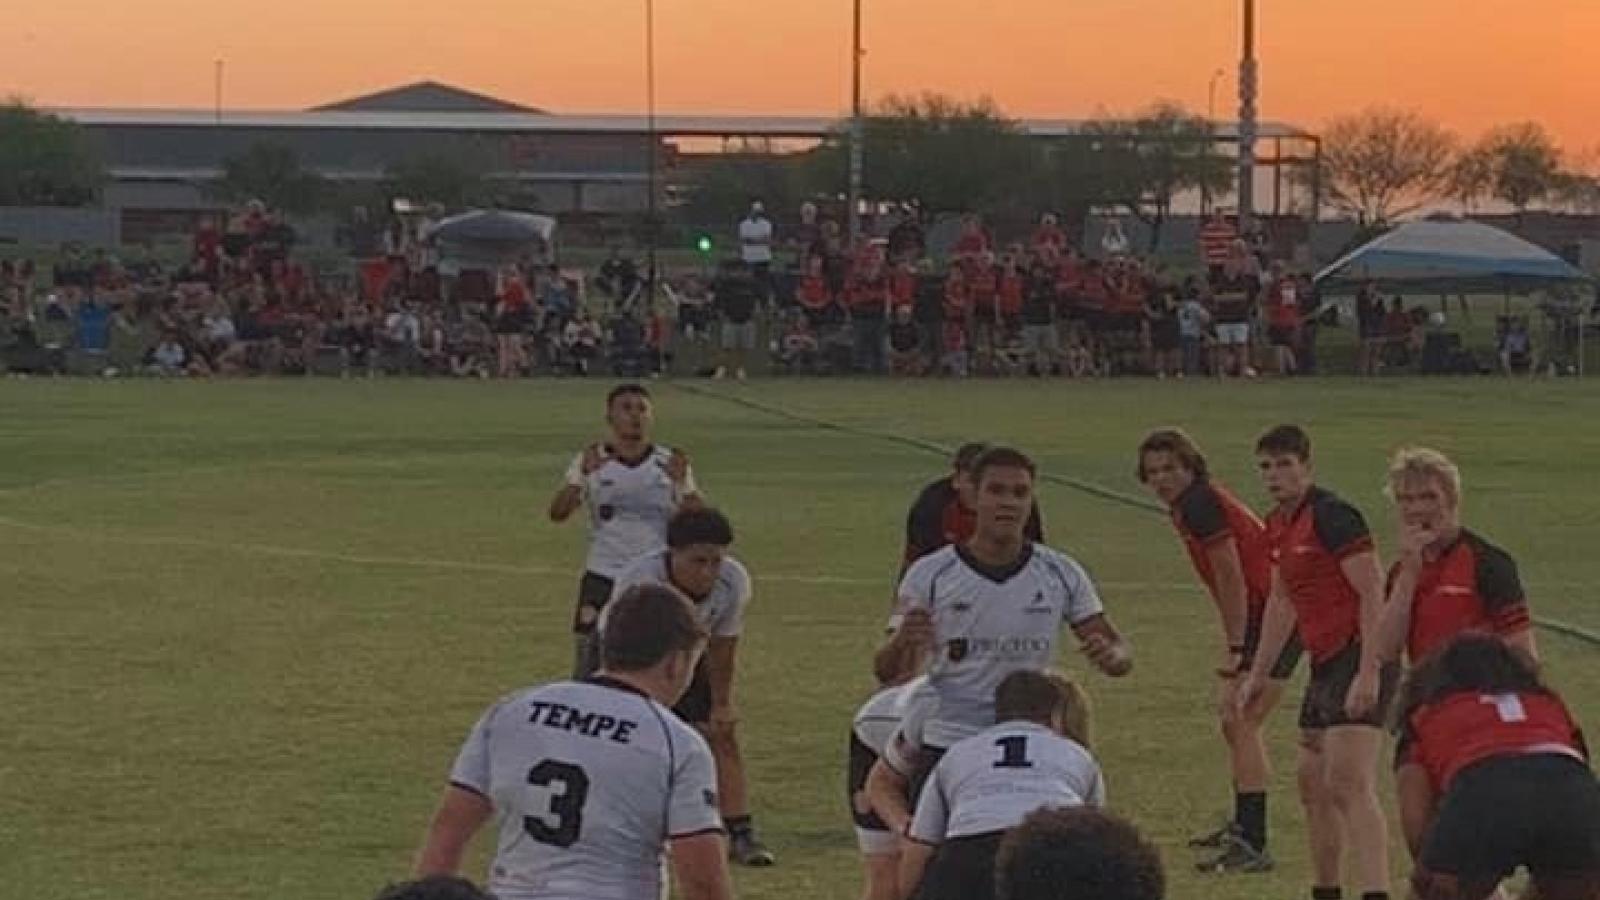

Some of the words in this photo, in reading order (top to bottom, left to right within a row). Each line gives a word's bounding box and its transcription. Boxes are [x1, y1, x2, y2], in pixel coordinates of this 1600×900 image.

[528, 701, 638, 744] TEMPE
[993, 735, 1033, 768] 1
[523, 758, 590, 848] 3
